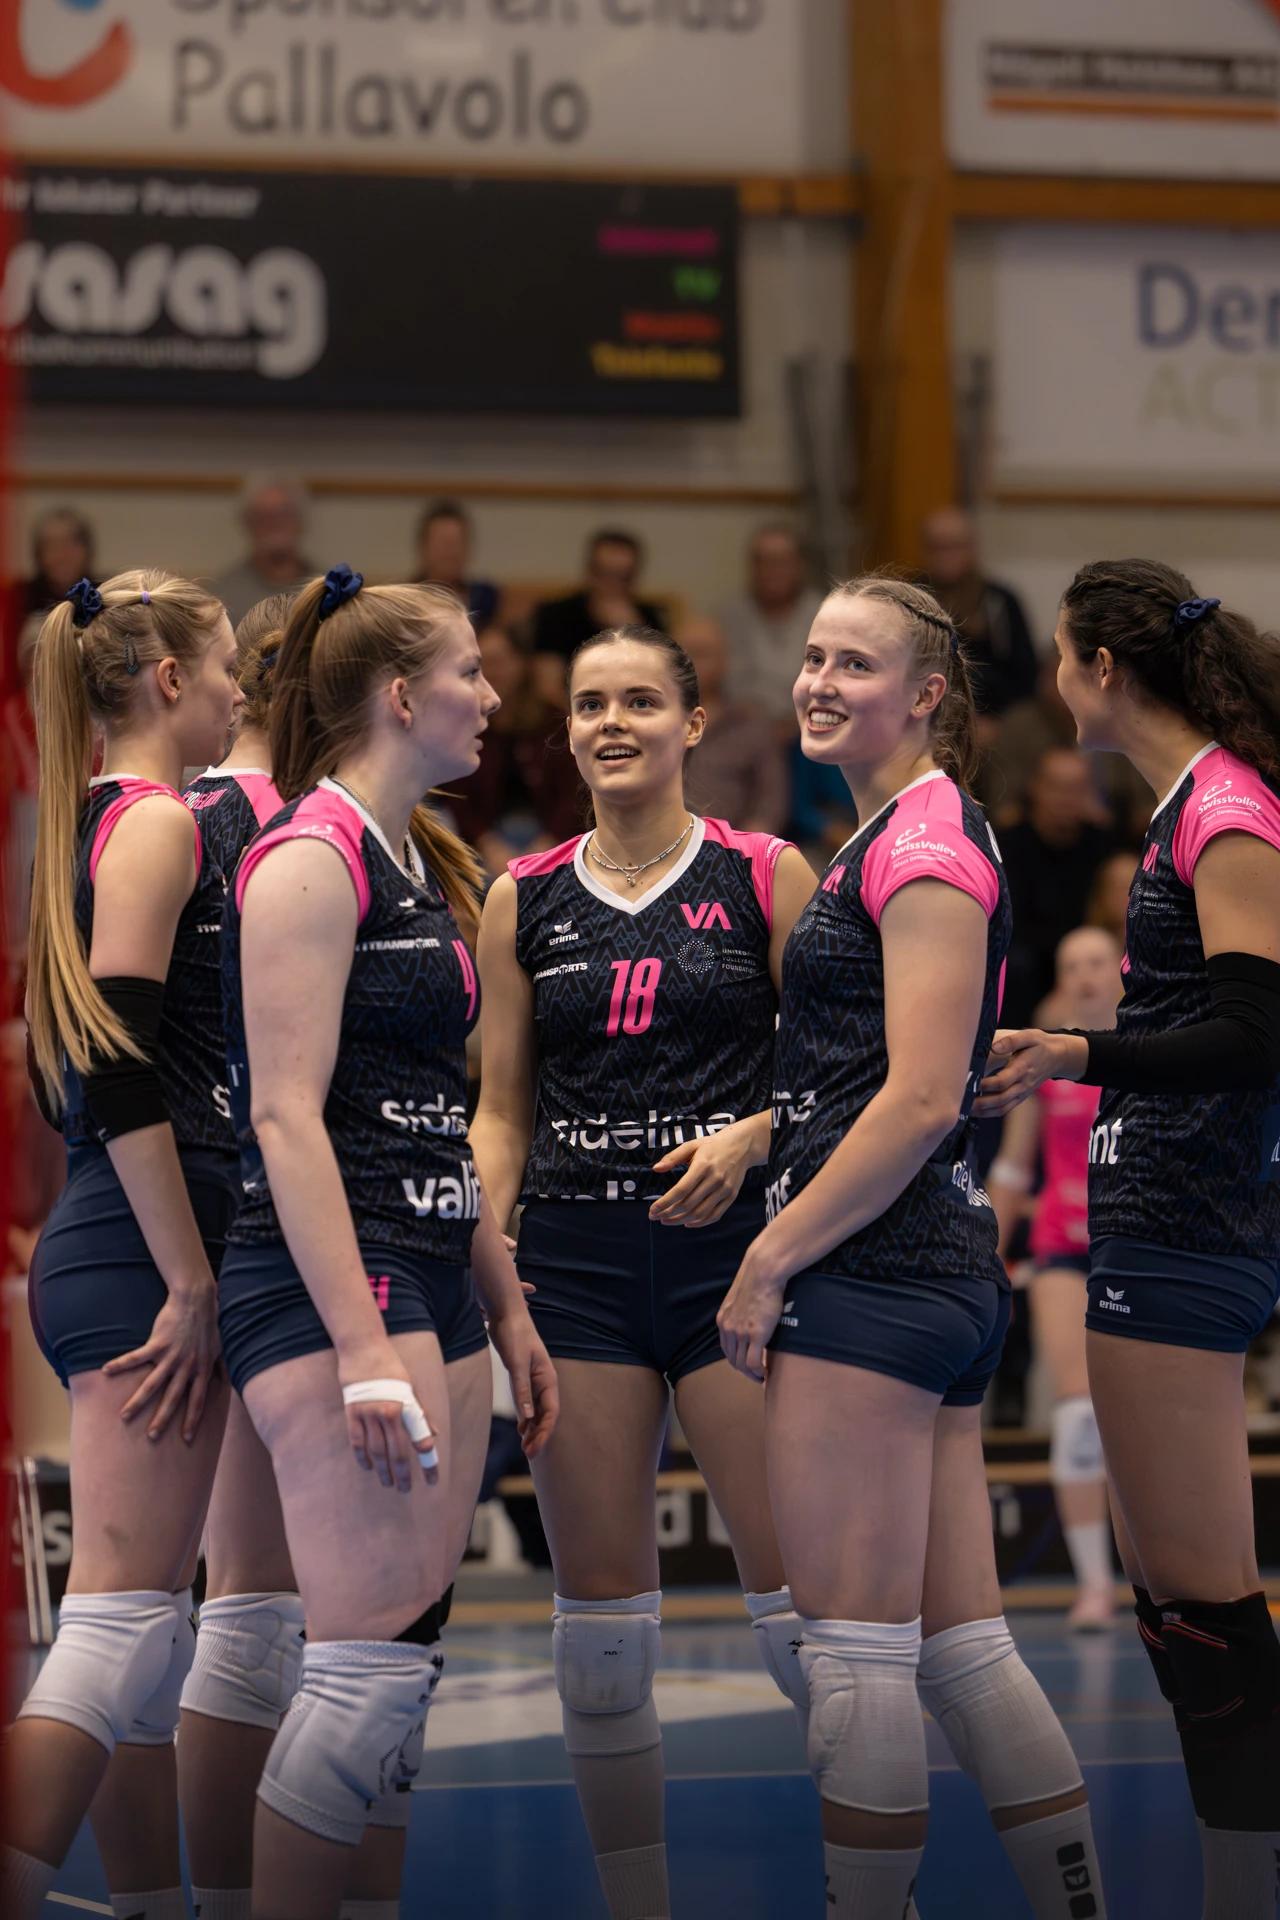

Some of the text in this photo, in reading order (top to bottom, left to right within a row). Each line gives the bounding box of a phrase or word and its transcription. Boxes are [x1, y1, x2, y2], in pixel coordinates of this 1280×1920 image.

[172, 38, 591, 143] Pallavolo
[1198, 795, 1262, 815] SwissVolley
[890, 840, 957, 858] SwissVolley
[548, 933, 579, 946] erima
[606, 957, 662, 1038] 18
[1099, 1299, 1131, 1314] erima
